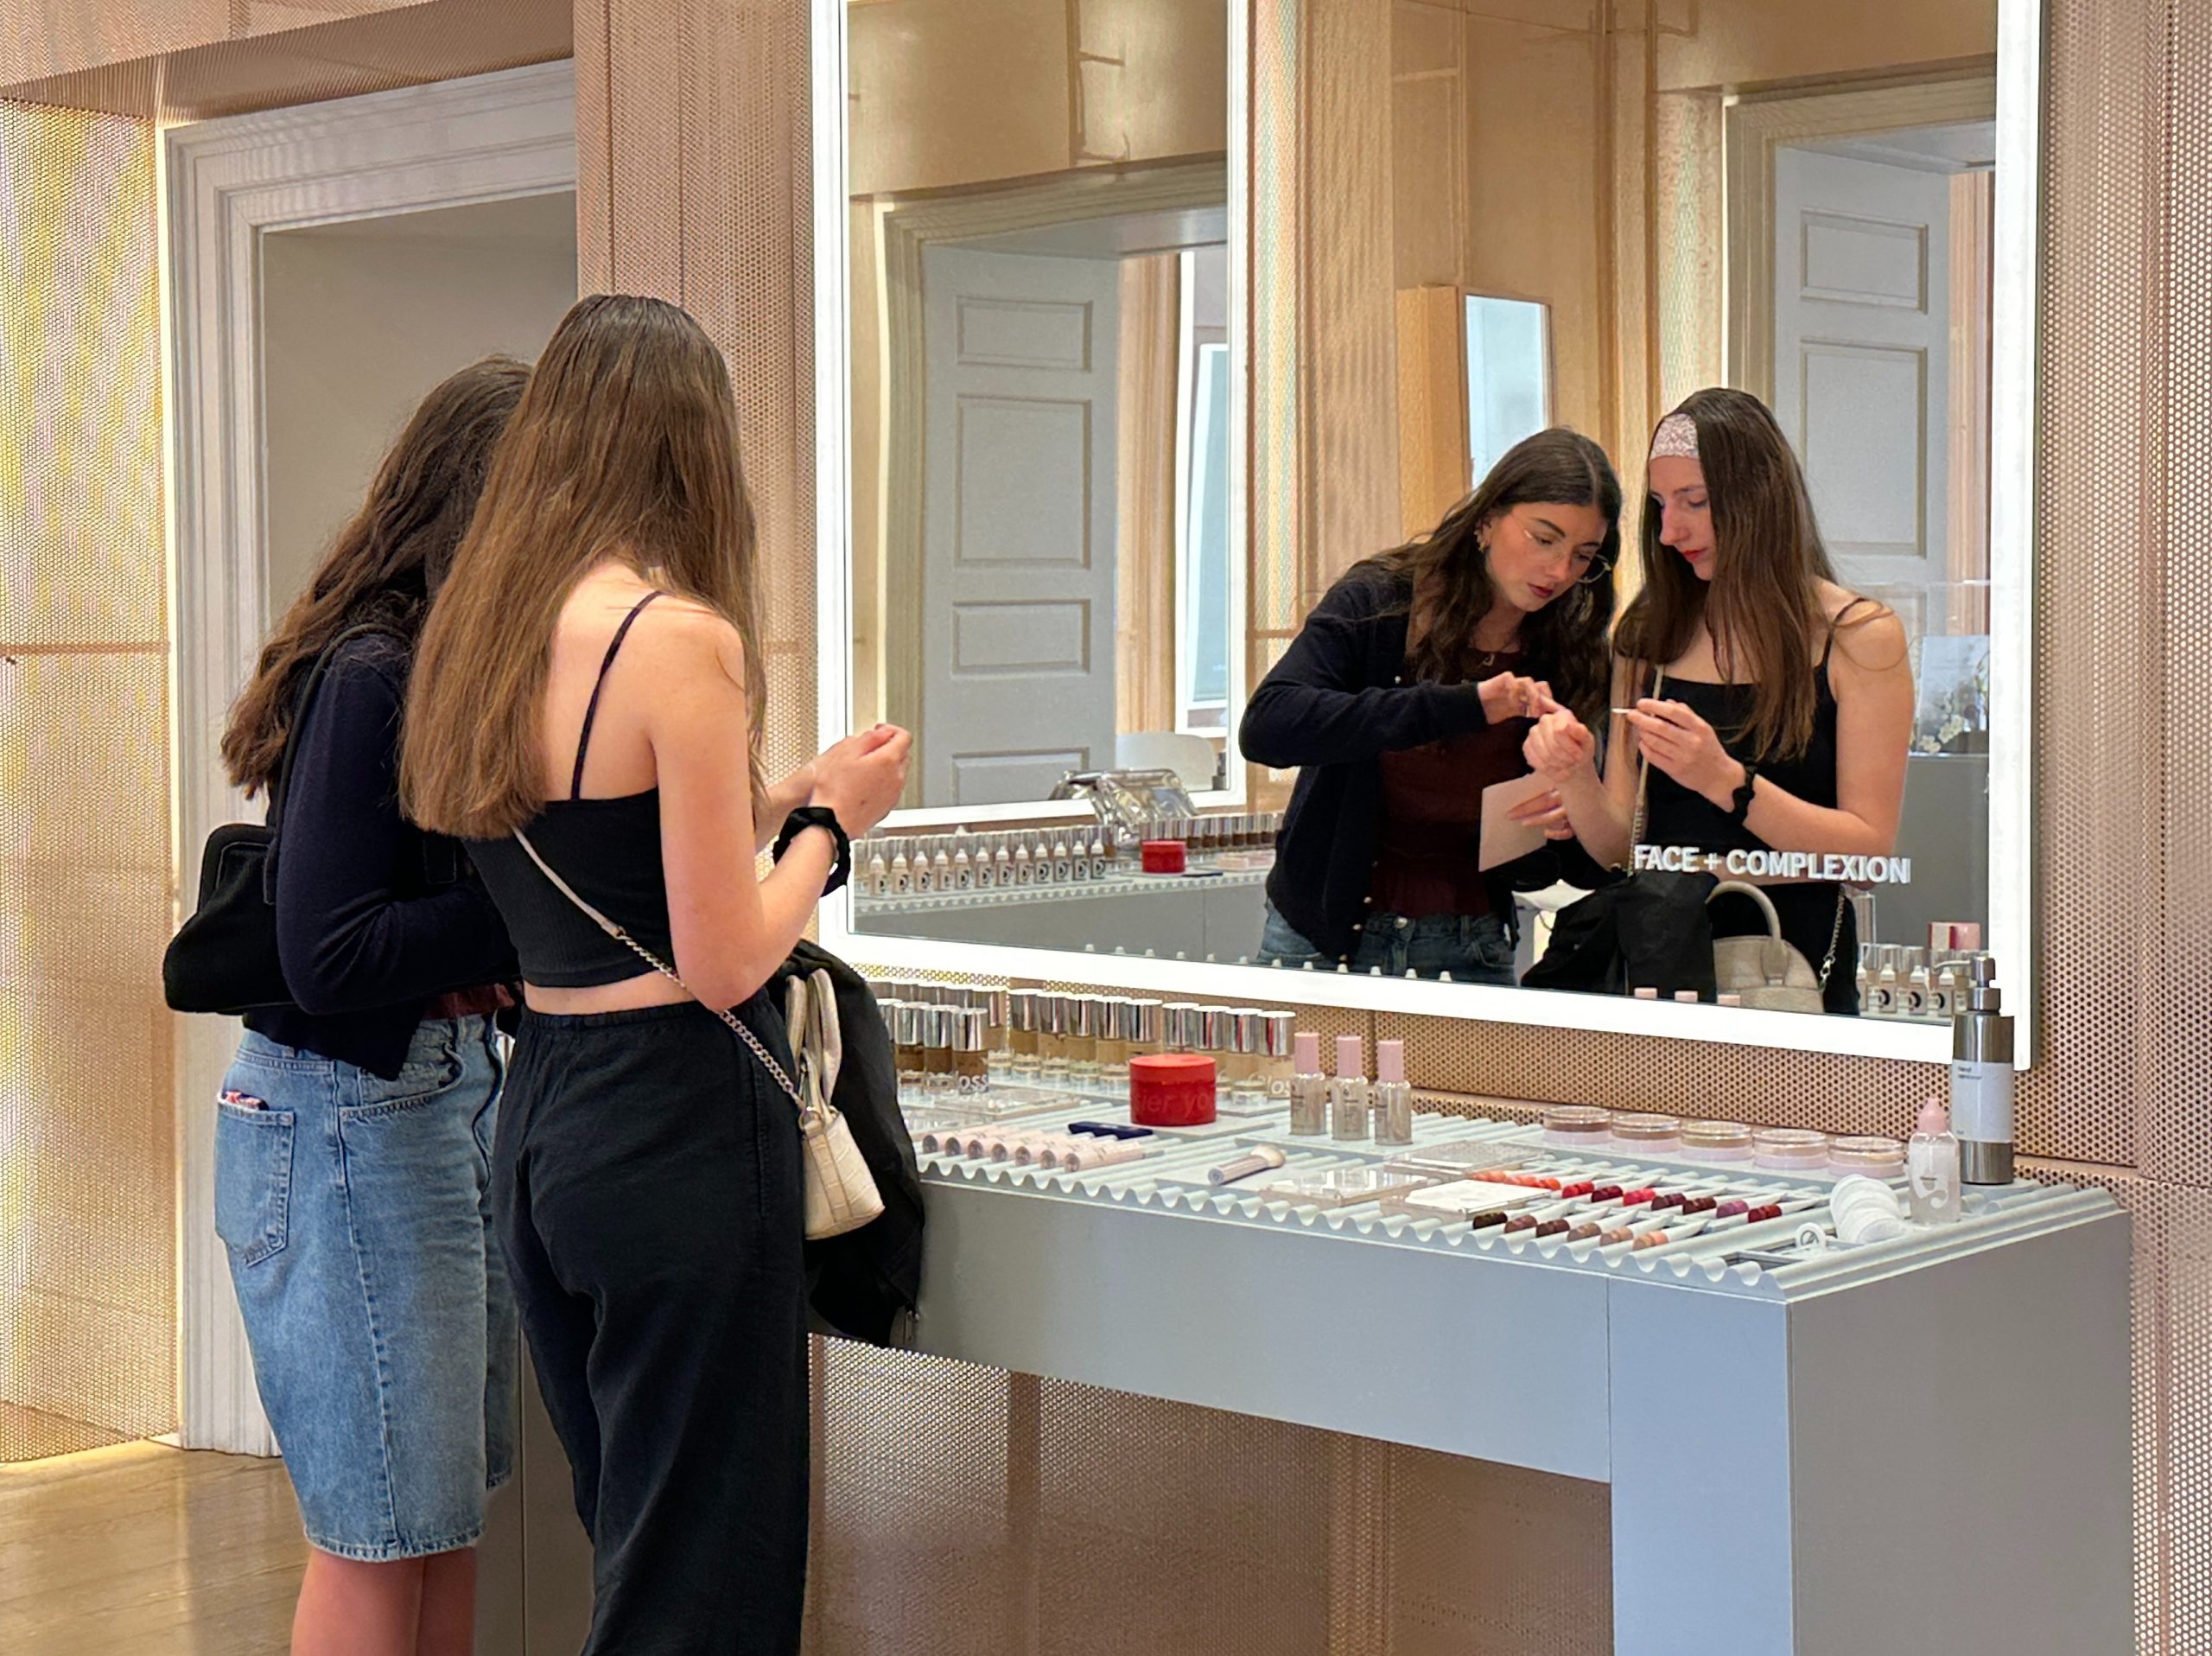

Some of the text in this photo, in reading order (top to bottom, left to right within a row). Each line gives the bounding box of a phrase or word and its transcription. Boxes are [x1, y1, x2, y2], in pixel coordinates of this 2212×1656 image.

[1634, 844, 1910, 883] FACE + COMPLEXION
